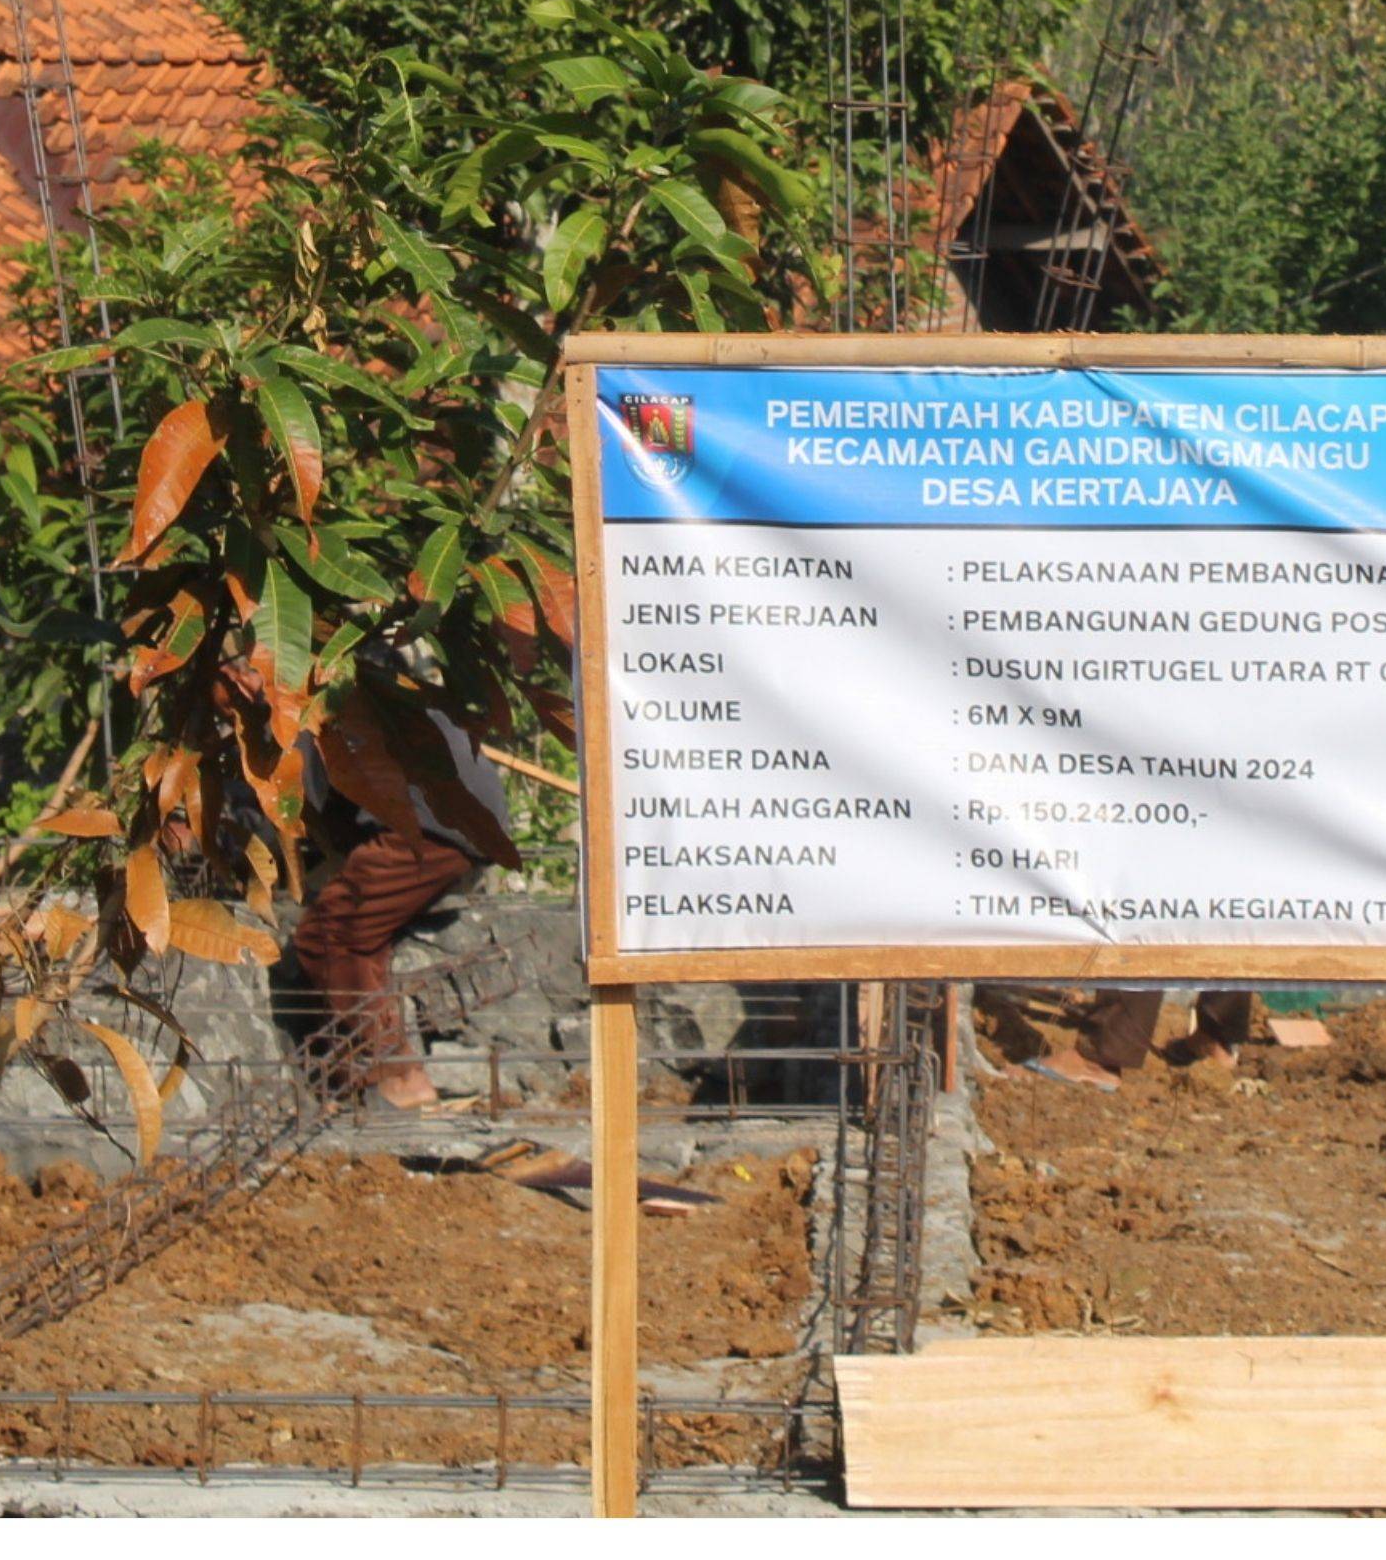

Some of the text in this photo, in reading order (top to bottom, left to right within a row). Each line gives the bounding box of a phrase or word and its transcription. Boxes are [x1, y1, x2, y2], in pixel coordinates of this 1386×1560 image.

[624, 395, 689, 404] CILACAP
[766, 400, 1000, 429] PEMERINTAH
[1009, 400, 1224, 431] KABUPATEN
[787, 437, 1370, 470] KECAMATAN GANDRUNGMANGU
[922, 478, 1238, 506] DESA KERTAJAYA
[621, 555, 705, 577] NAMA
[715, 556, 853, 580] KEGIATAN
[963, 561, 1179, 583] PELAKSANAAN
[622, 603, 700, 625] JENIS
[710, 604, 878, 628] PEKERJAAN
[963, 610, 1190, 632] PEMBANGUNAN
[1199, 611, 1322, 633] GEDUNG
[623, 652, 724, 674] LOKASI
[966, 657, 1063, 681] DUSUN
[1073, 659, 1223, 682] IGIRTUGEL
[1231, 661, 1326, 682] UTARA
[1336, 661, 1371, 682] RT
[622, 700, 741, 722] VOLUME
[968, 705, 1009, 726] 6M
[1017, 705, 1034, 726] X
[1043, 708, 1082, 728] 9M
[623, 748, 742, 770] SUMBER
[751, 749, 830, 770] DANA
[968, 752, 1049, 774] DANA
[1058, 753, 1135, 776] DESA
[1141, 756, 1237, 779] TAHUN
[1246, 759, 1314, 780] 2024
[625, 797, 740, 818] JUMLAH
[749, 797, 911, 819] ANGGARAN
[968, 800, 1009, 825] Rp.
[1021, 802, 1208, 827] 150.242.000,-
[625, 845, 837, 867] PELAKSANAAN
[970, 848, 1003, 869] 60
[1012, 849, 1079, 870] HARI
[626, 893, 795, 916] PELAKSANA
[970, 895, 1019, 916] TIM
[1030, 895, 1198, 920] PELAKSANA
[1209, 899, 1353, 920] KEGIATAN
